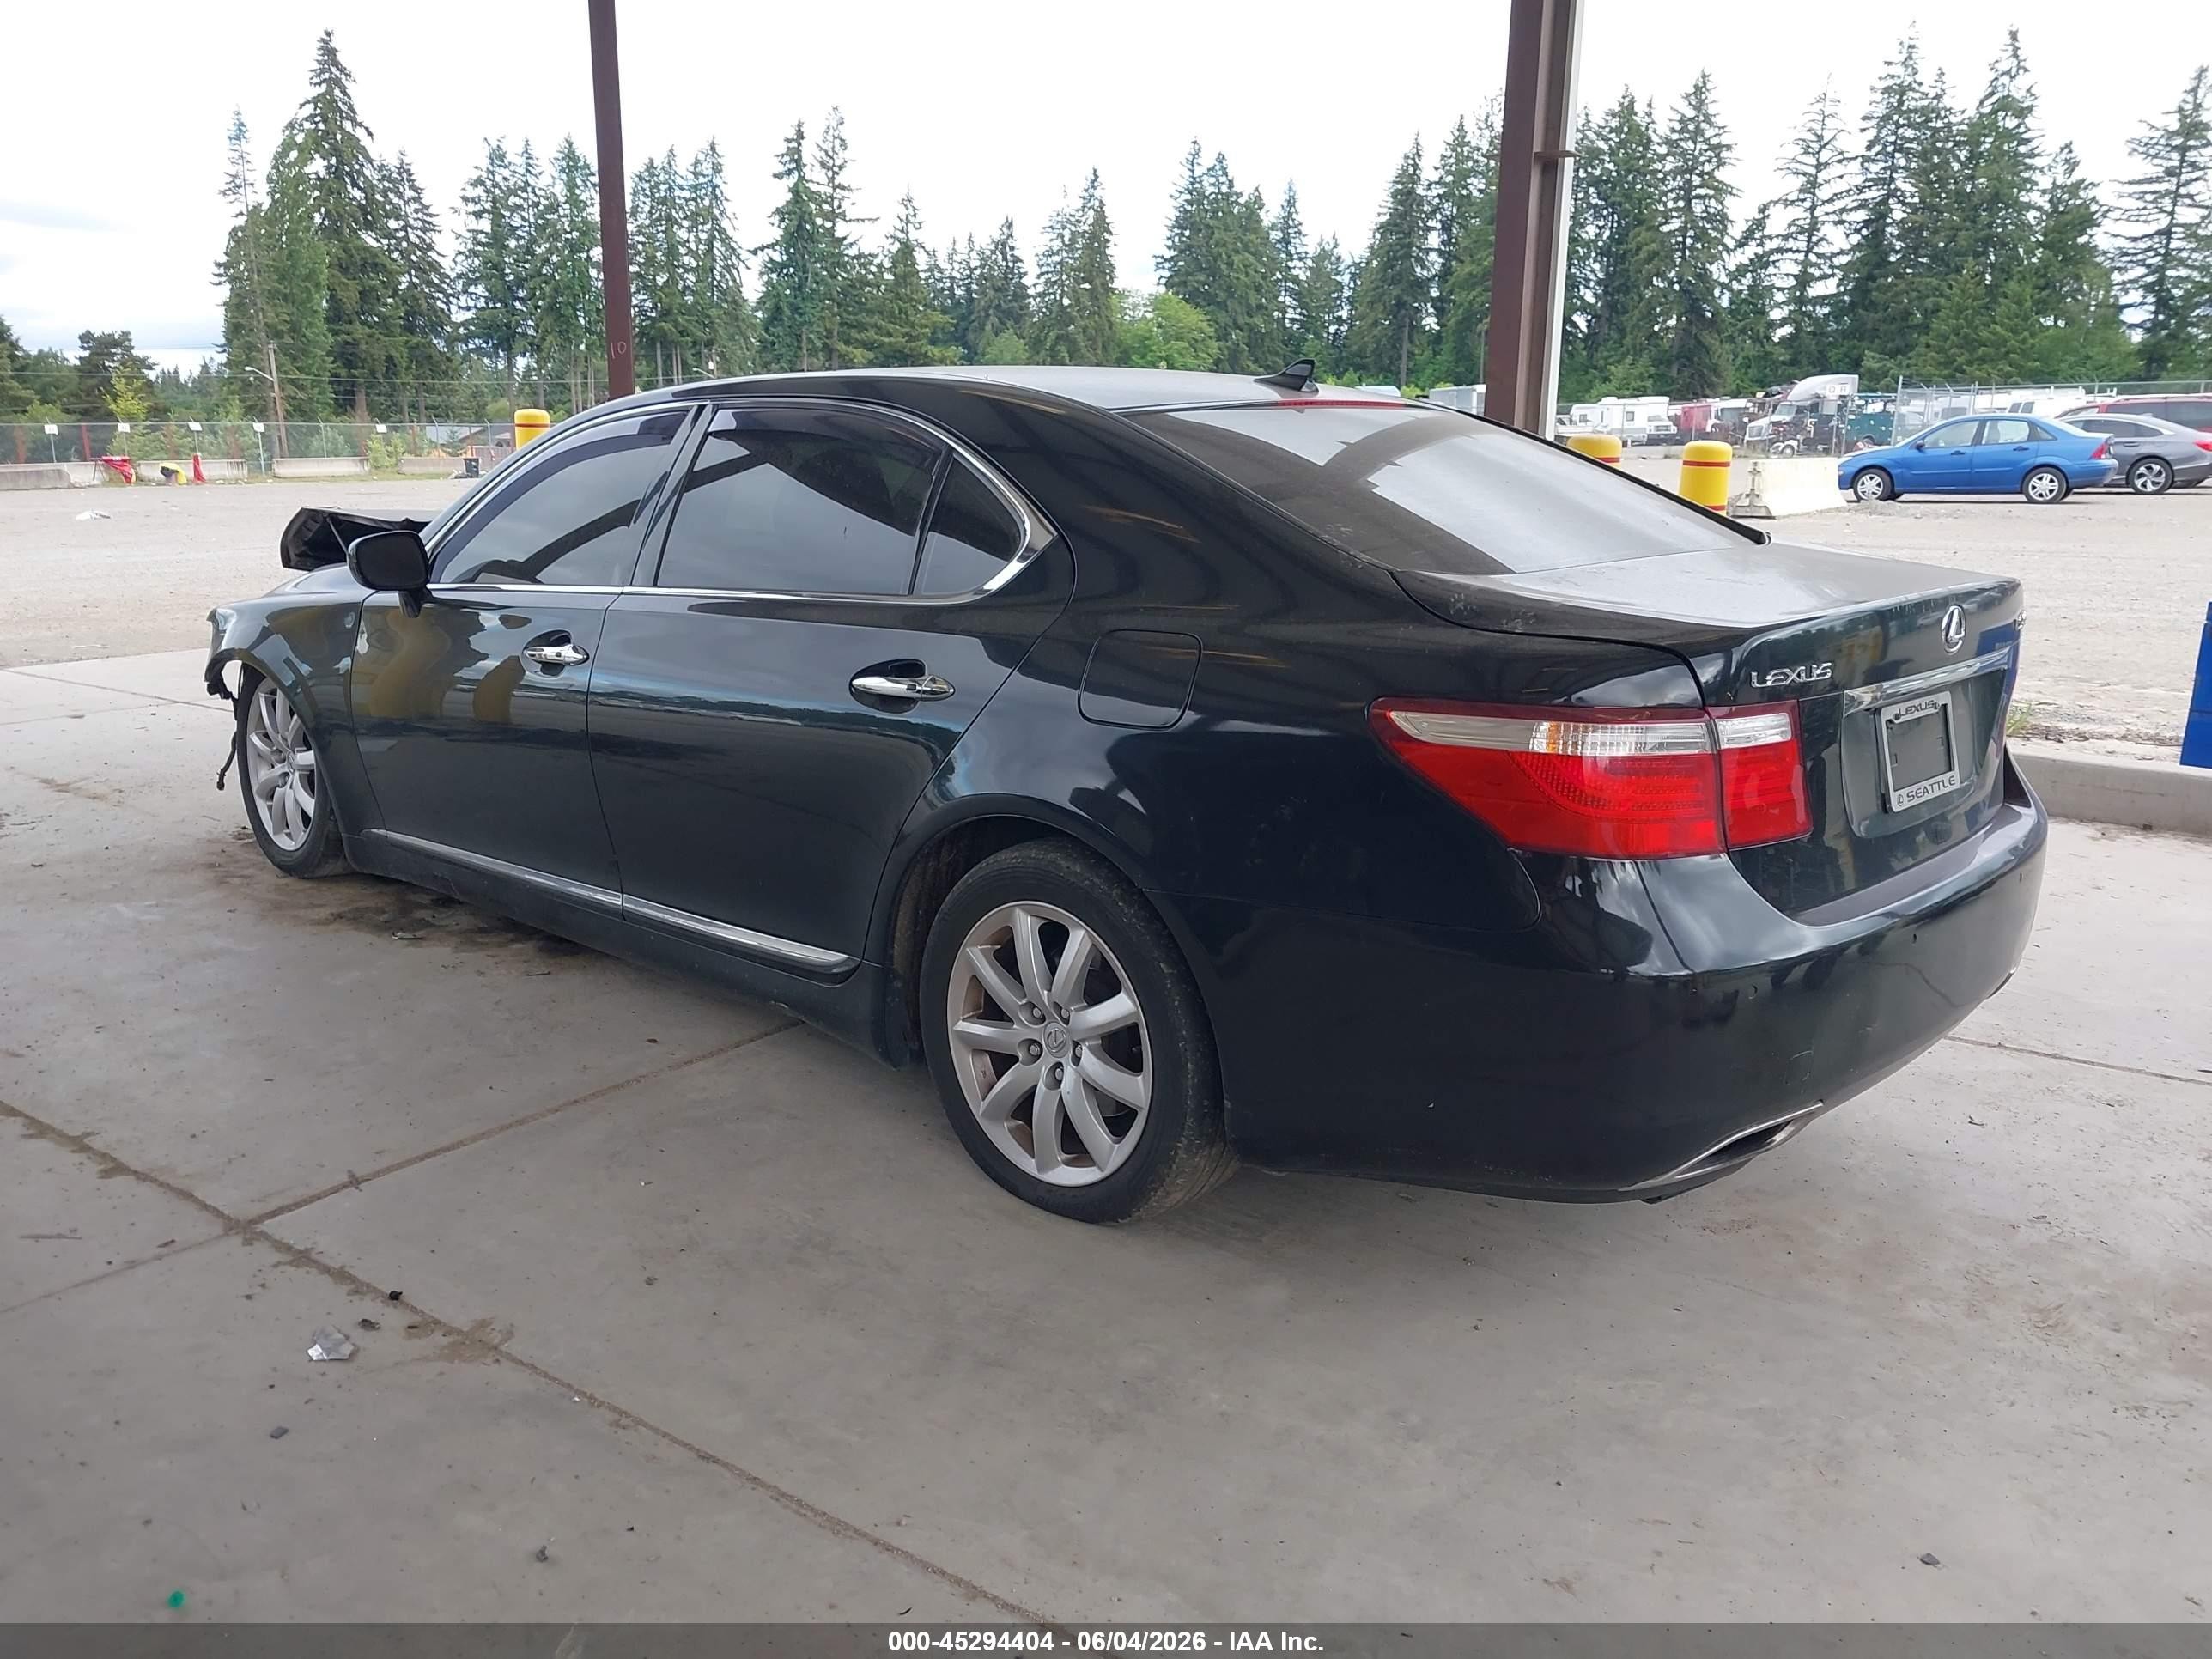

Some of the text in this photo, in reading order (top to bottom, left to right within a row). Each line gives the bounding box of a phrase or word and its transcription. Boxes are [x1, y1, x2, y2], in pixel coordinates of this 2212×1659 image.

[611, 341, 627, 359] 10
[1751, 662, 1832, 687] LEXUS
[1898, 700, 1936, 718] LEXUS
[1905, 775, 1956, 802] SEATTLE
